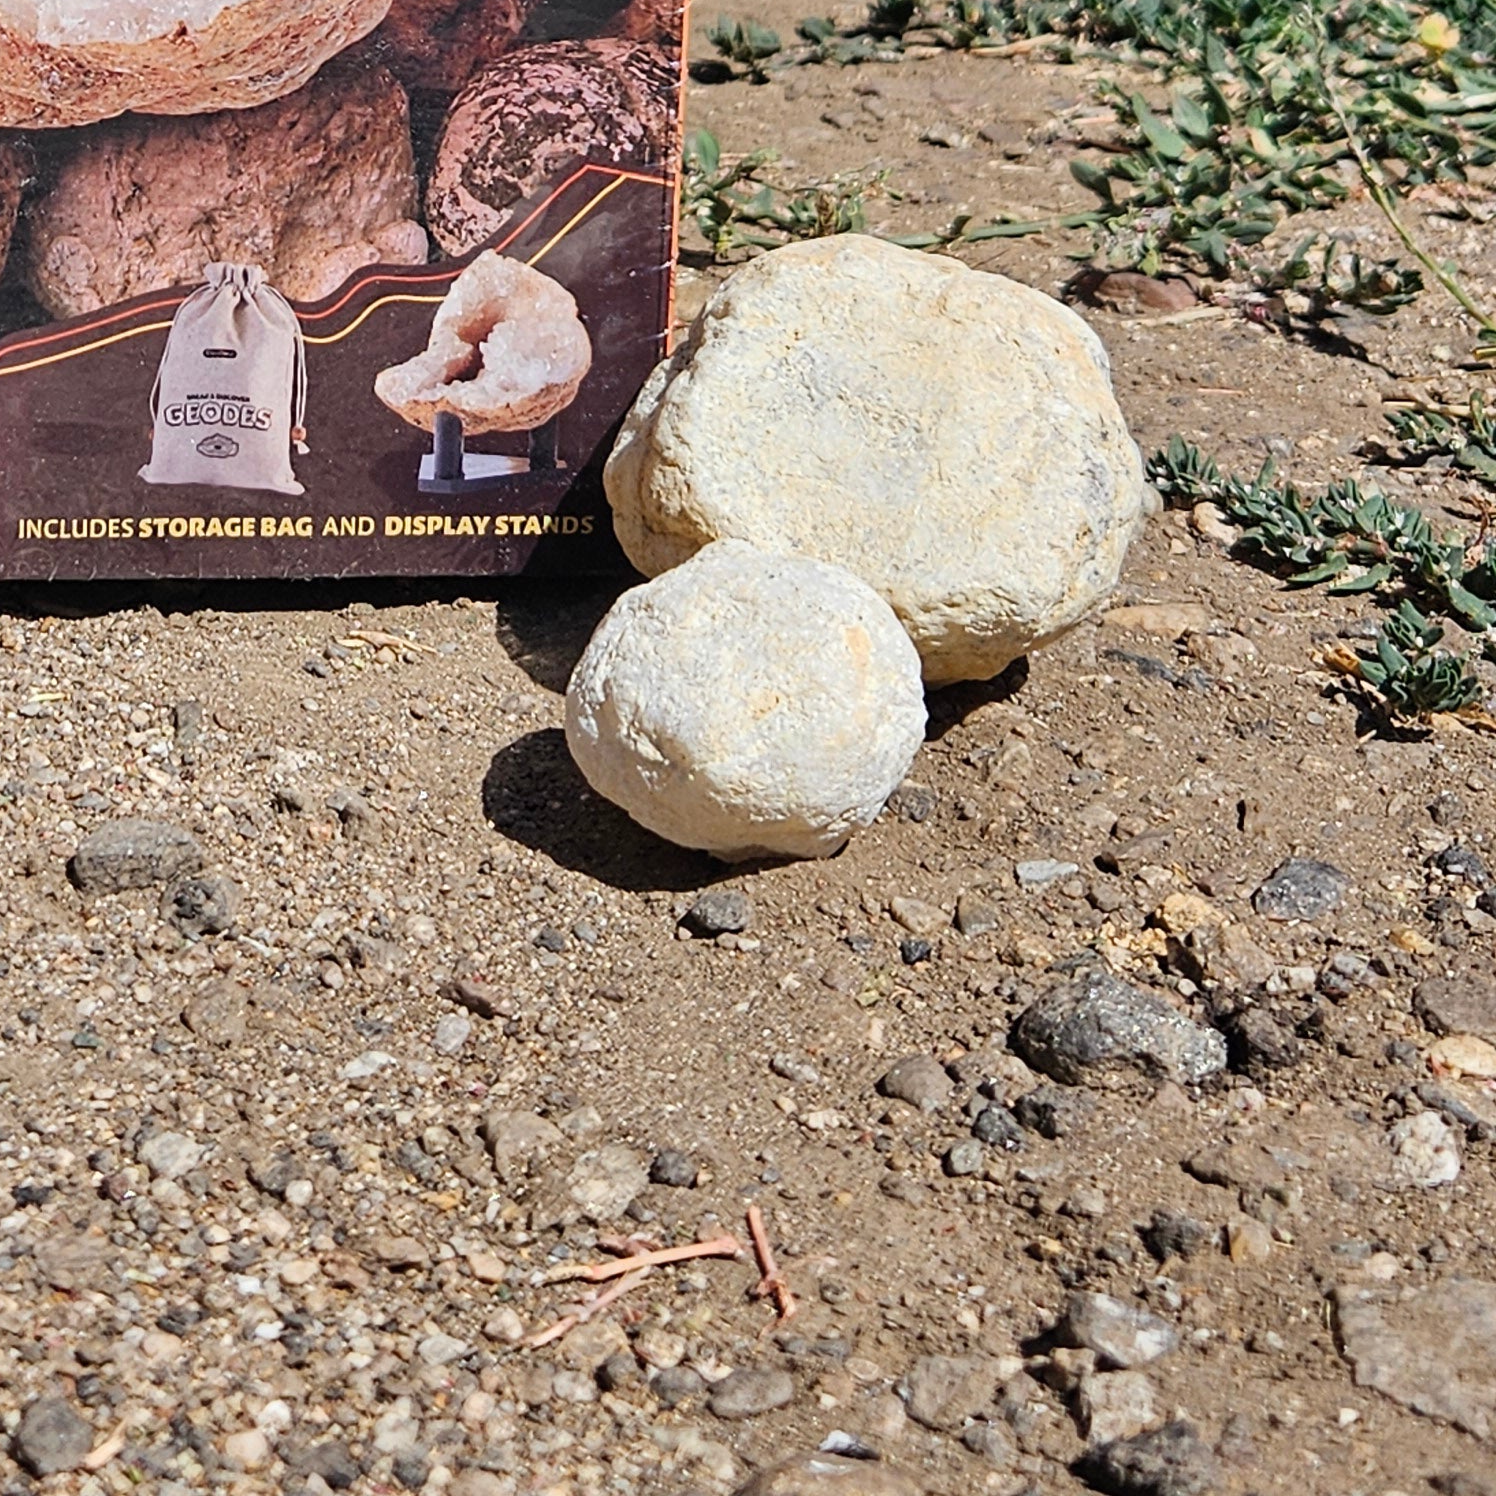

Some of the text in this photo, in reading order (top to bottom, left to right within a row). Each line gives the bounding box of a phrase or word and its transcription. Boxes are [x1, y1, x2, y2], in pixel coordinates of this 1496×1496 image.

[164, 401, 273, 431] GEODES
[17, 515, 594, 539] INCLUDES STORAGE BAG AND DISPLAY STANDS
